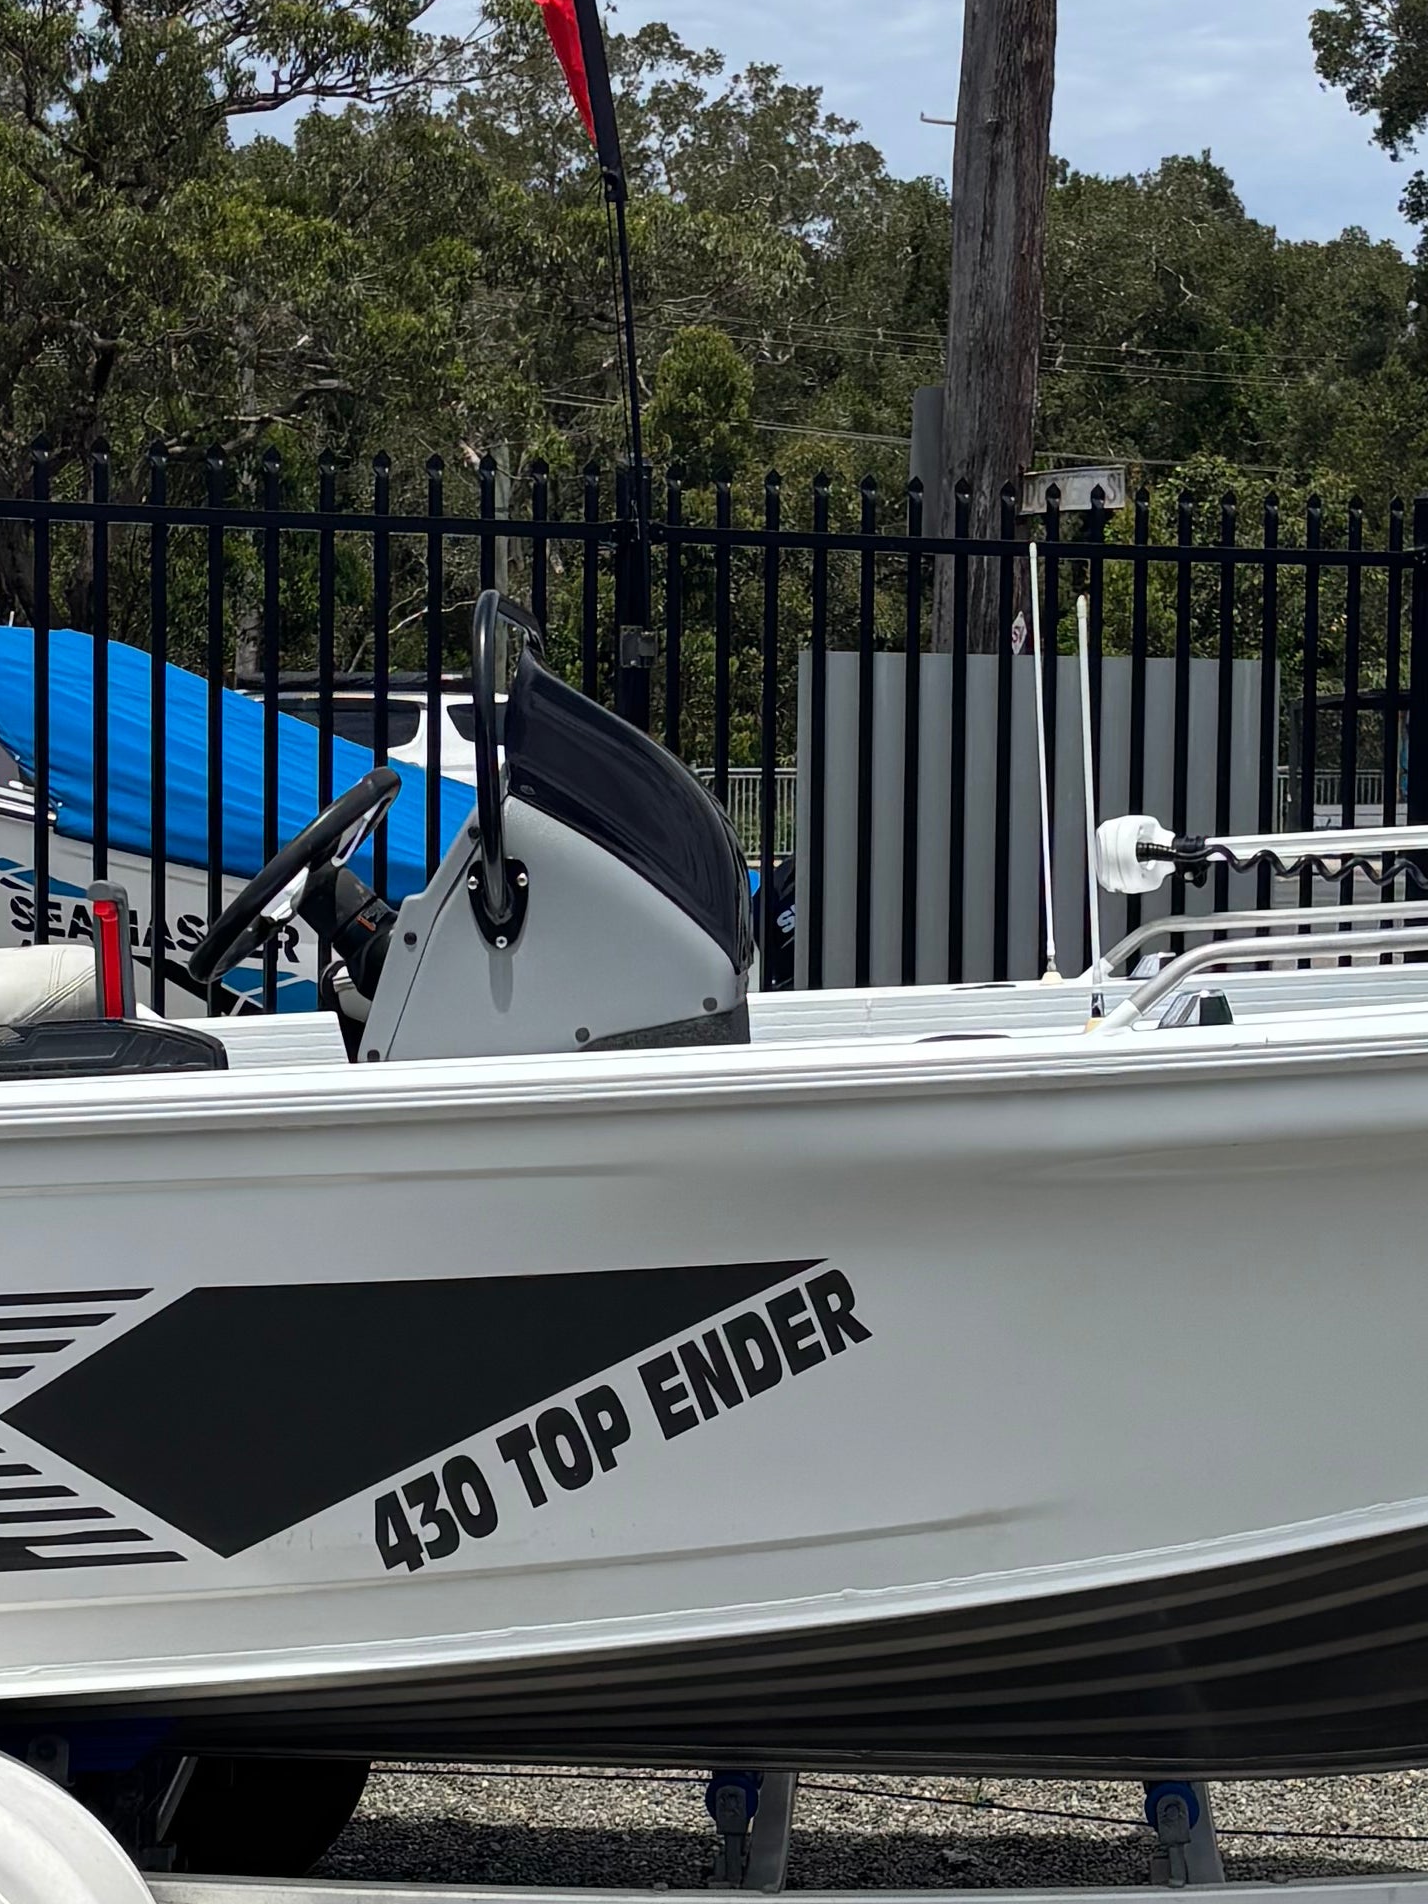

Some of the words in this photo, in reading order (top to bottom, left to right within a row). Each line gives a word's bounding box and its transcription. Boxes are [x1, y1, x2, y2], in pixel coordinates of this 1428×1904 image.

[9, 895, 300, 964] SEAASR
[375, 1454, 498, 1573] 430
[495, 1384, 632, 1509] TOP
[637, 1269, 873, 1441] ENDER
